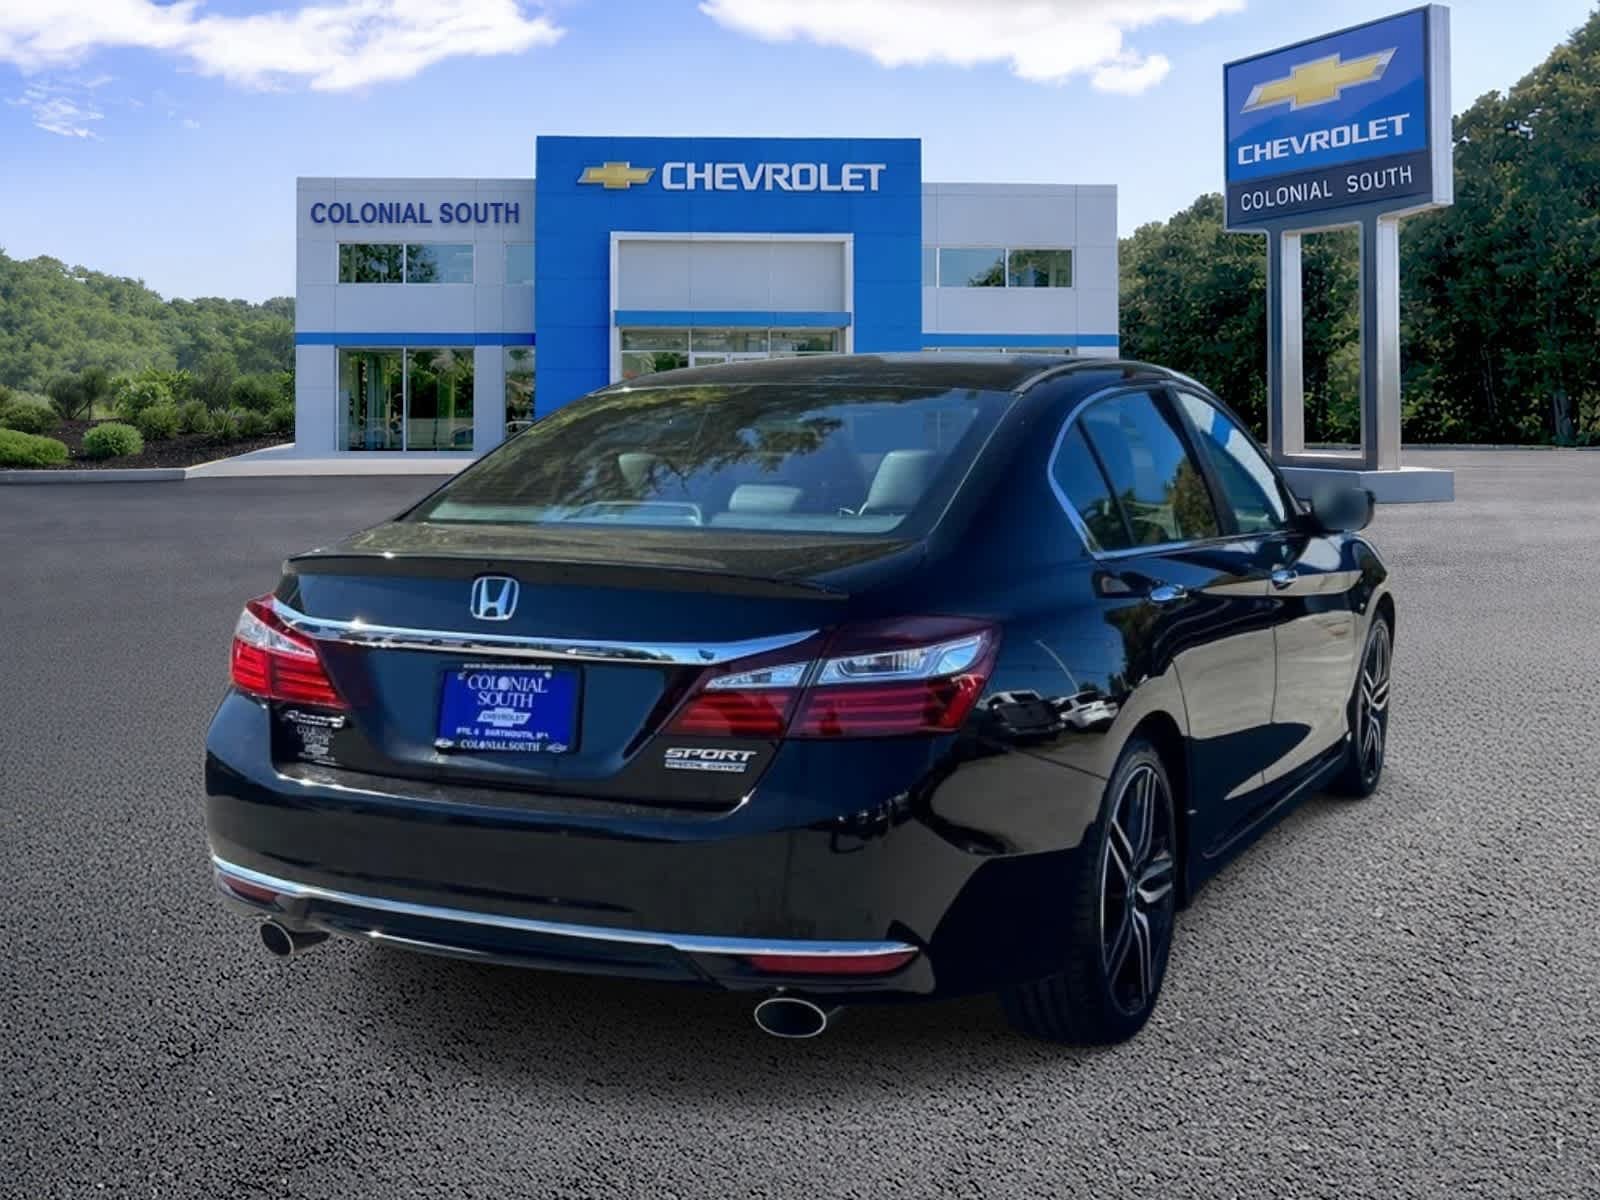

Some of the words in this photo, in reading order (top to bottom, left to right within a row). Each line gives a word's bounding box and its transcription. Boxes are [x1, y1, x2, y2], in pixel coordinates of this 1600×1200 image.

[1237, 113, 1410, 165] CHEVROLET
[662, 162, 887, 191] CHEVROLET
[1240, 180, 1333, 211] COLONIAL
[1346, 165, 1413, 193] SOUTH
[310, 202, 433, 224] COLONIAL
[439, 202, 520, 224] SOUTH
[468, 674, 548, 693] COLONIAL
[477, 691, 533, 708] SOUTH
[664, 748, 758, 762] SPORT
